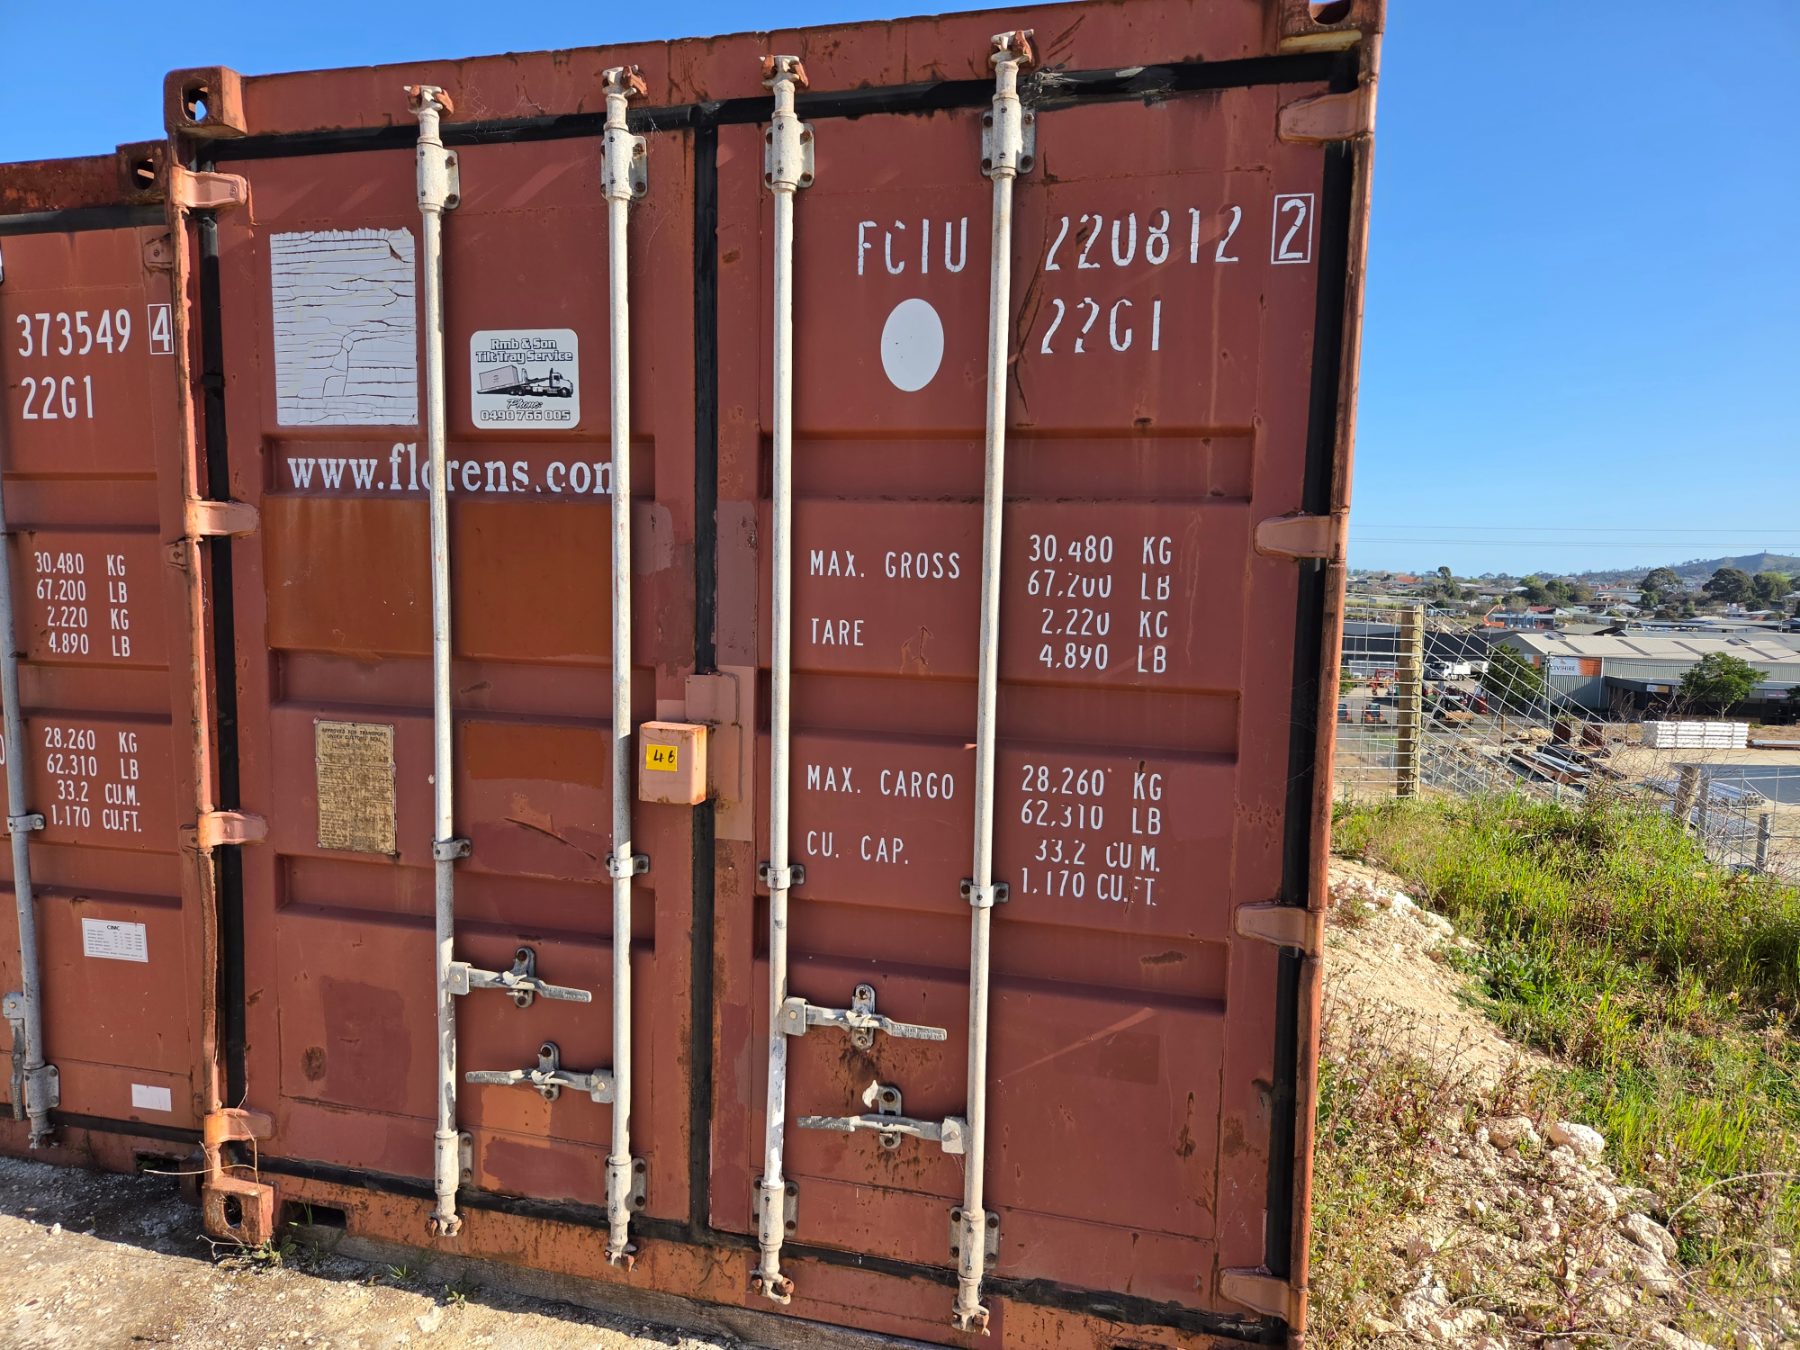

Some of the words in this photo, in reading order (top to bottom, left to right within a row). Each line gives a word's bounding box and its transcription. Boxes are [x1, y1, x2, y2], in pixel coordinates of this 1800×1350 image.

[858, 217, 967, 275] FCIU
[1045, 206, 1241, 270] 220812
[1277, 197, 1307, 260] 2
[17, 309, 130, 356] 373549
[152, 306, 171, 352] 4
[1041, 298, 1161, 354] 22G1
[476, 351, 498, 363] Tilt
[497, 351, 525, 364] Tray
[526, 350, 574, 361] Service
[490, 338, 520, 350] Rmb
[521, 338, 531, 349] &
[532, 338, 557, 349] Son
[21, 375, 93, 420] 22G1
[480, 410, 516, 421] 0490
[515, 410, 542, 421] 766
[544, 410, 571, 421] 005
[35, 552, 84, 574] 30,480
[107, 555, 125, 576] KG
[811, 550, 864, 577] MAX.
[886, 552, 959, 578] GROSS
[1143, 537, 1171, 564] KG
[37, 579, 85, 601] 67,200
[109, 582, 127, 603] LB
[1142, 573, 1169, 600] LB
[48, 606, 87, 627] 2,220
[111, 609, 128, 630] KG
[812, 618, 863, 645] TARE
[1042, 608, 1109, 635] 2,220
[49, 632, 88, 654] 4,890
[112, 636, 130, 656] LB
[1040, 643, 1107, 670] 4,890
[1138, 645, 1166, 673] LB
[45, 727, 95, 750] 28,260
[119, 732, 137, 752] KG
[47, 754, 96, 776] 62,310
[121, 759, 138, 779] LB
[58, 780, 88, 801] 33.2
[105, 784, 140, 805] CU.M.
[808, 765, 860, 793] MAX.
[881, 770, 953, 799] CARGO
[1022, 765, 1104, 796] 28,260
[1134, 772, 1161, 800] KG
[52, 805, 90, 827] 1,170
[103, 809, 141, 832] CU.FT.
[1022, 799, 1103, 829] 62,310
[1133, 808, 1160, 834] LB
[808, 831, 838, 857] CU.
[861, 836, 908, 864] CAP.
[1036, 840, 1085, 864] 33.2
[1022, 868, 1084, 897] 1,170
